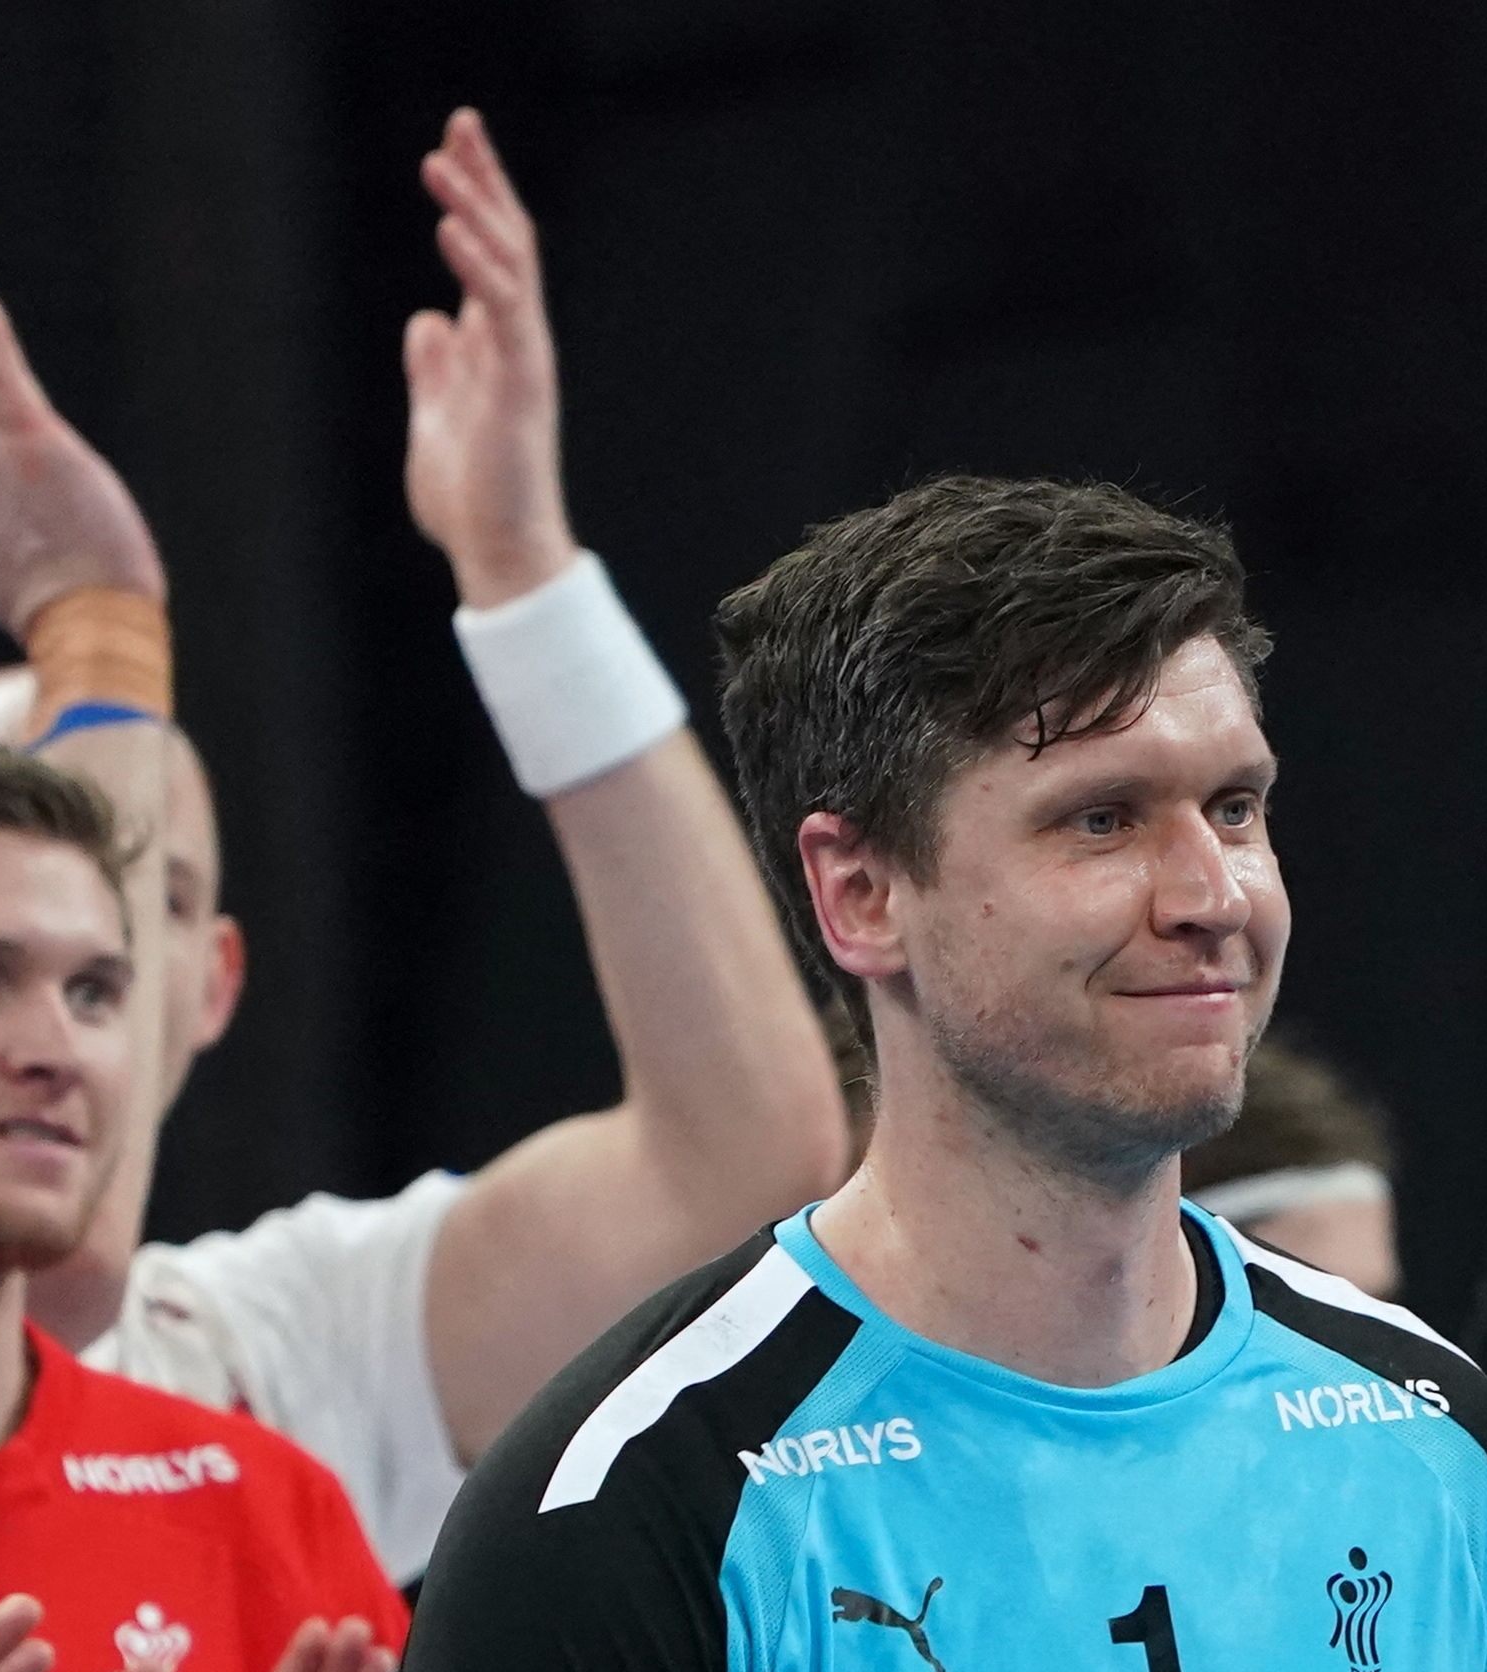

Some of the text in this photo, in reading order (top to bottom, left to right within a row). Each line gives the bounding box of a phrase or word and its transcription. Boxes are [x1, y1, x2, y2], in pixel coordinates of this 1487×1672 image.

[1274, 1378, 1451, 1432] NORLYS
[61, 1442, 240, 1496] NORLYS
[737, 1416, 923, 1485] NORLYS
